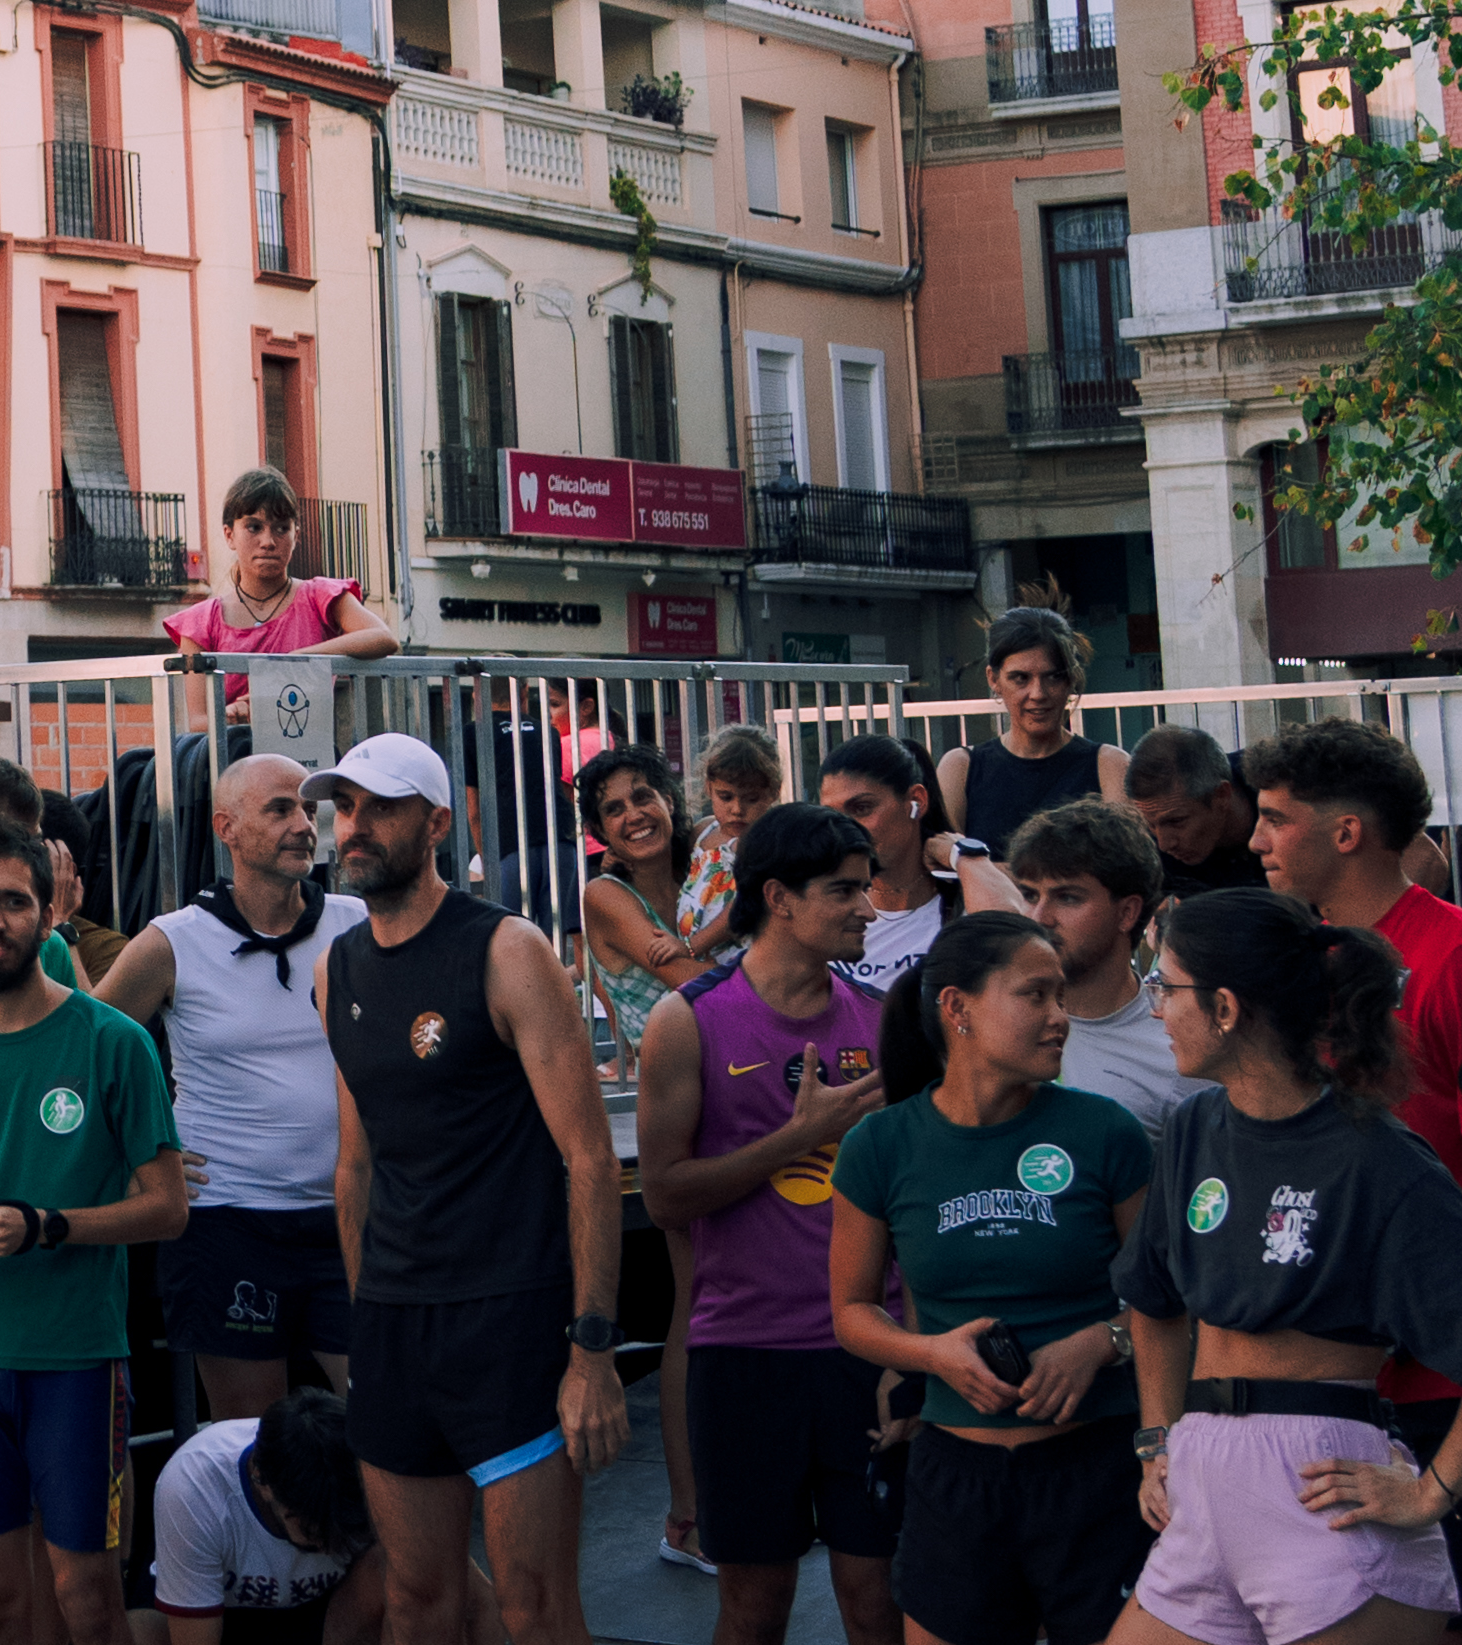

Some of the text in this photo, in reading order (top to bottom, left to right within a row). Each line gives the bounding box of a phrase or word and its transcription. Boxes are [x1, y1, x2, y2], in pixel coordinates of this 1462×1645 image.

[580, 476, 610, 496] Dental
[573, 500, 596, 519] Caro
[1271, 1185, 1316, 1208] Ghost
[938, 1189, 1057, 1233] BROOKLYN
